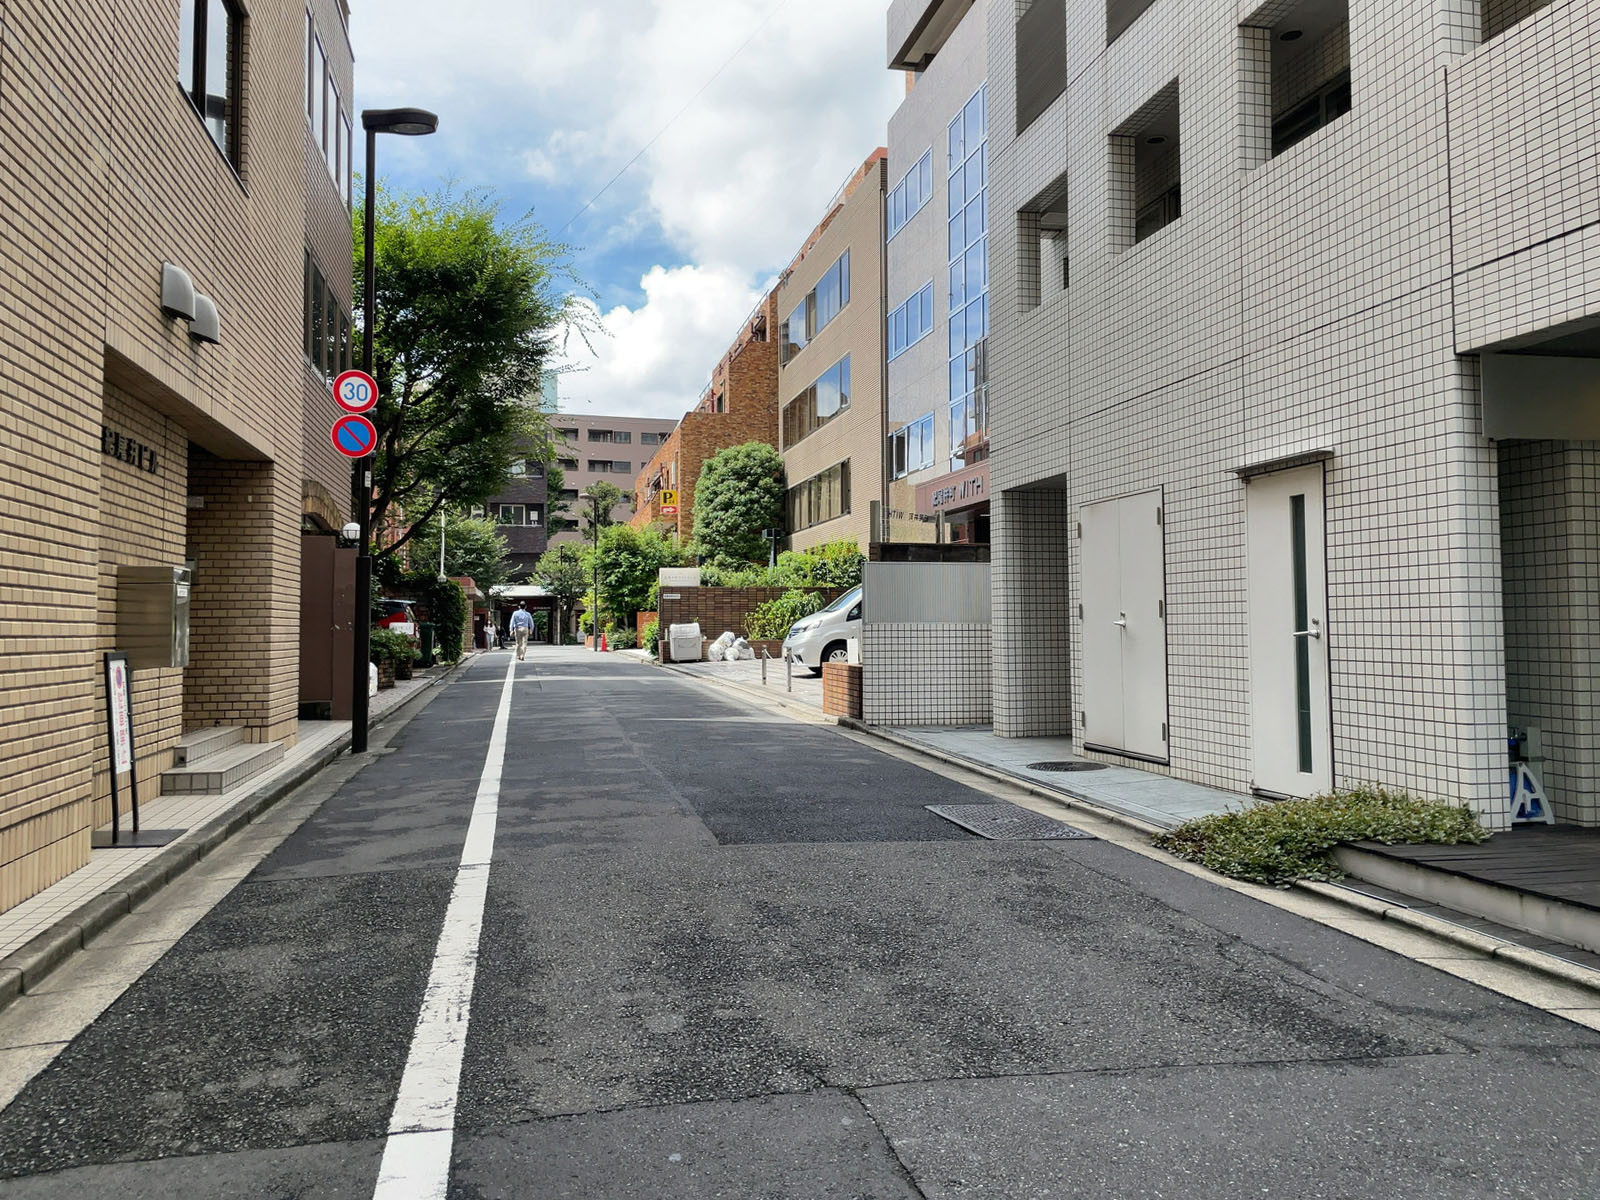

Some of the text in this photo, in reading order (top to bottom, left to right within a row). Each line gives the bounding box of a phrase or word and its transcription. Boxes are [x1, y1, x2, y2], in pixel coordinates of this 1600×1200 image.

[343, 382, 368, 402] 30
[958, 475, 984, 500] WITH
[663, 492, 673, 504] P
